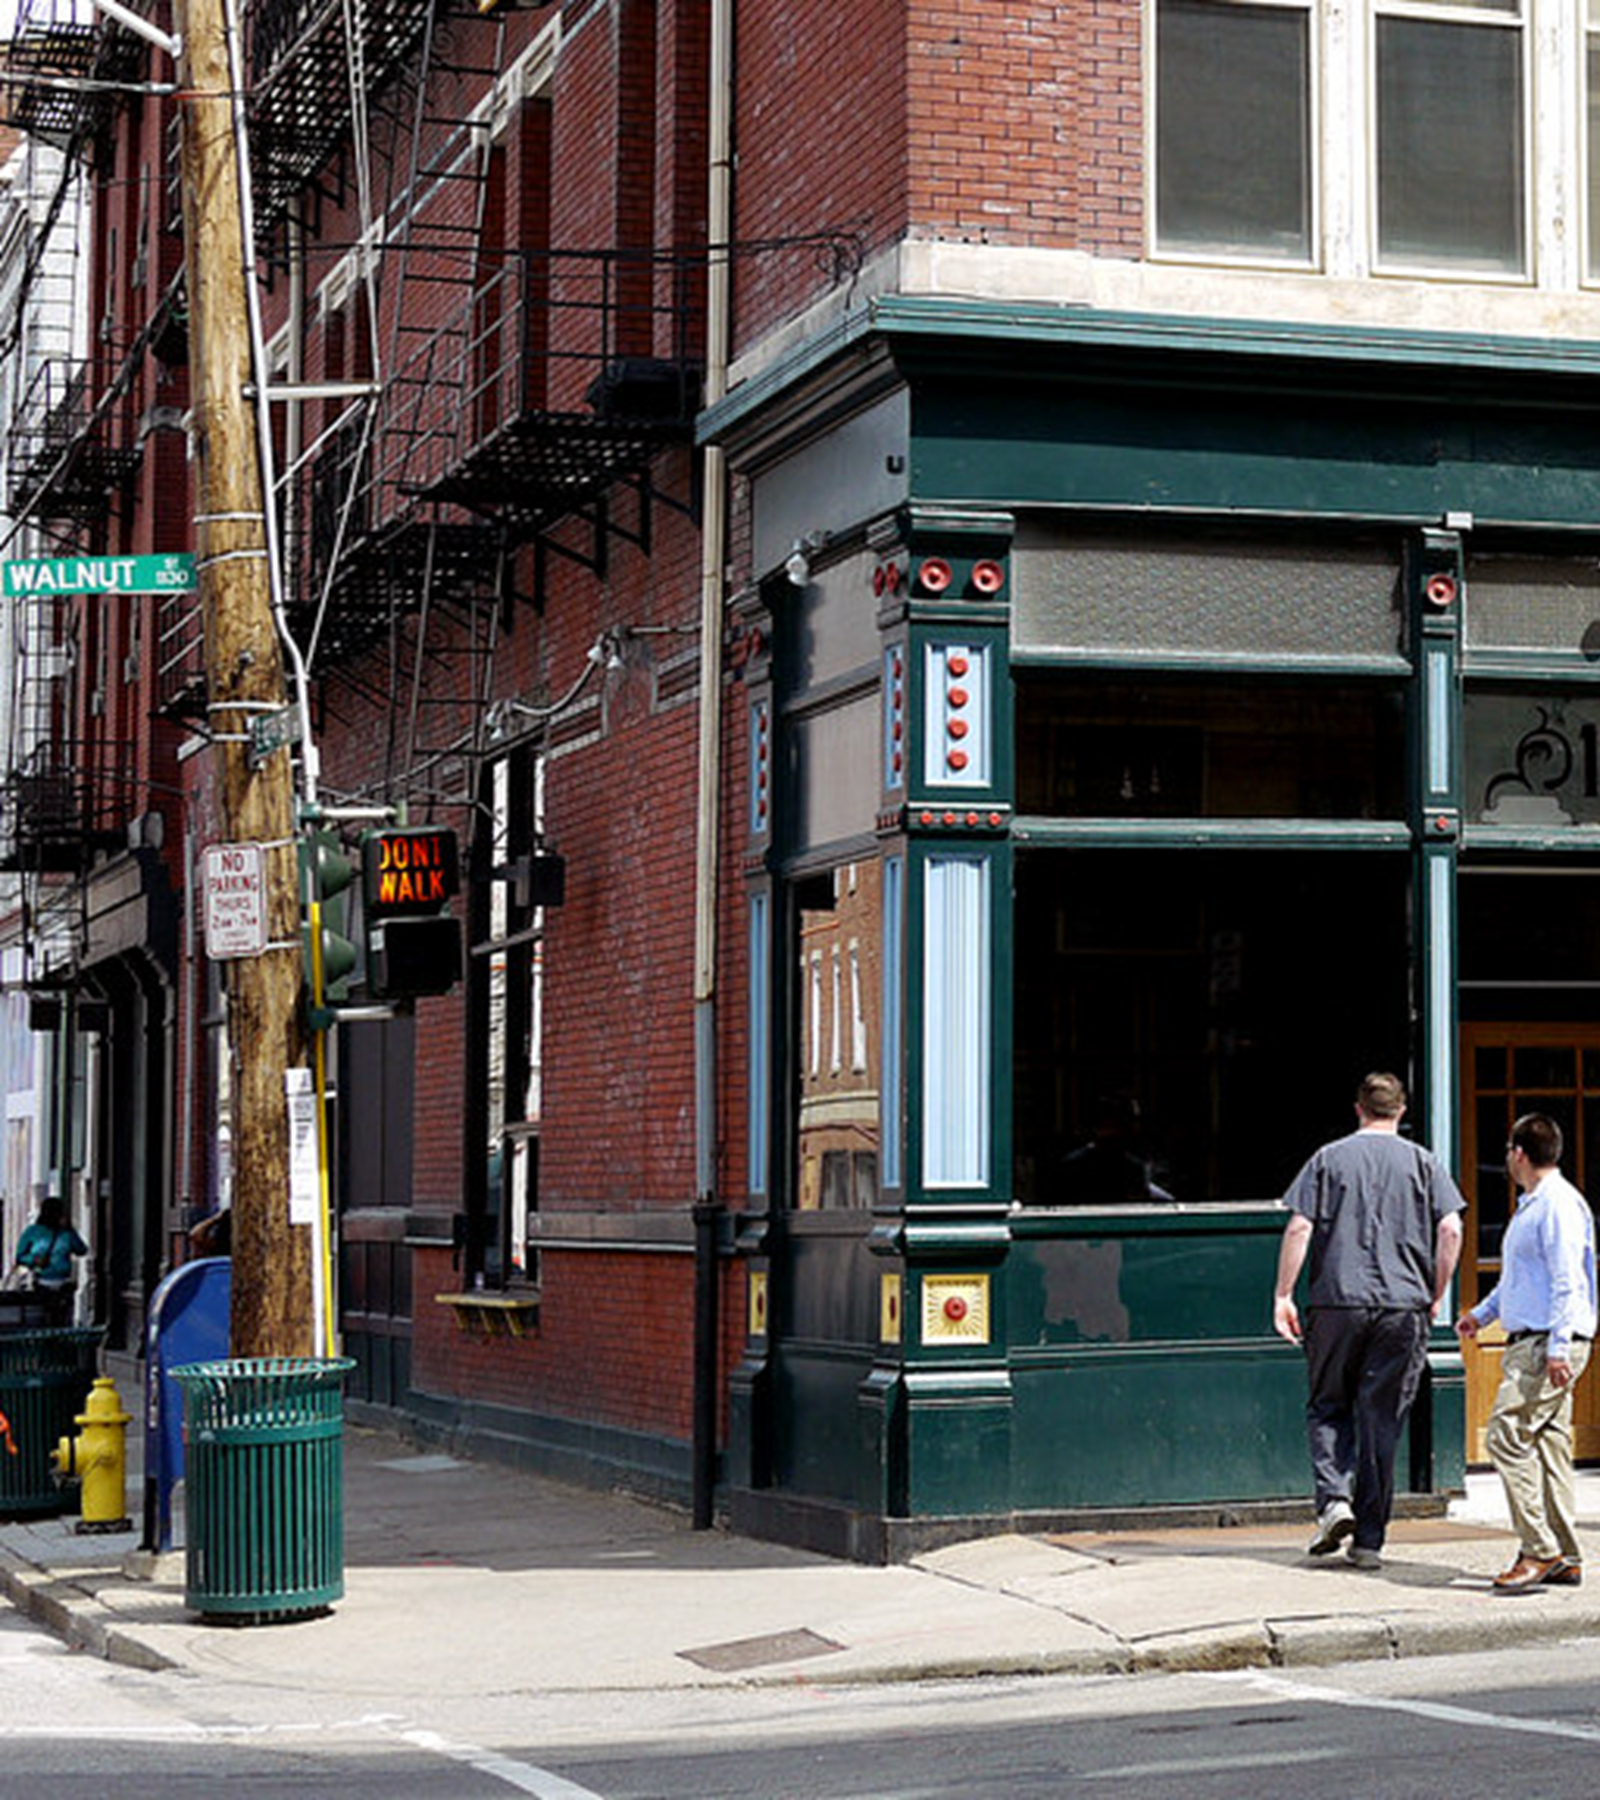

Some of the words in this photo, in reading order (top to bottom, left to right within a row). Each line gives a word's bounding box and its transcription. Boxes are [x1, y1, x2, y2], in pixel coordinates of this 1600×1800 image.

[10, 559, 136, 592] WALNUT
[222, 852, 245, 873] NO
[208, 874, 259, 893] PARKING
[378, 868, 446, 904] WALK
[214, 896, 252, 912] THURS
